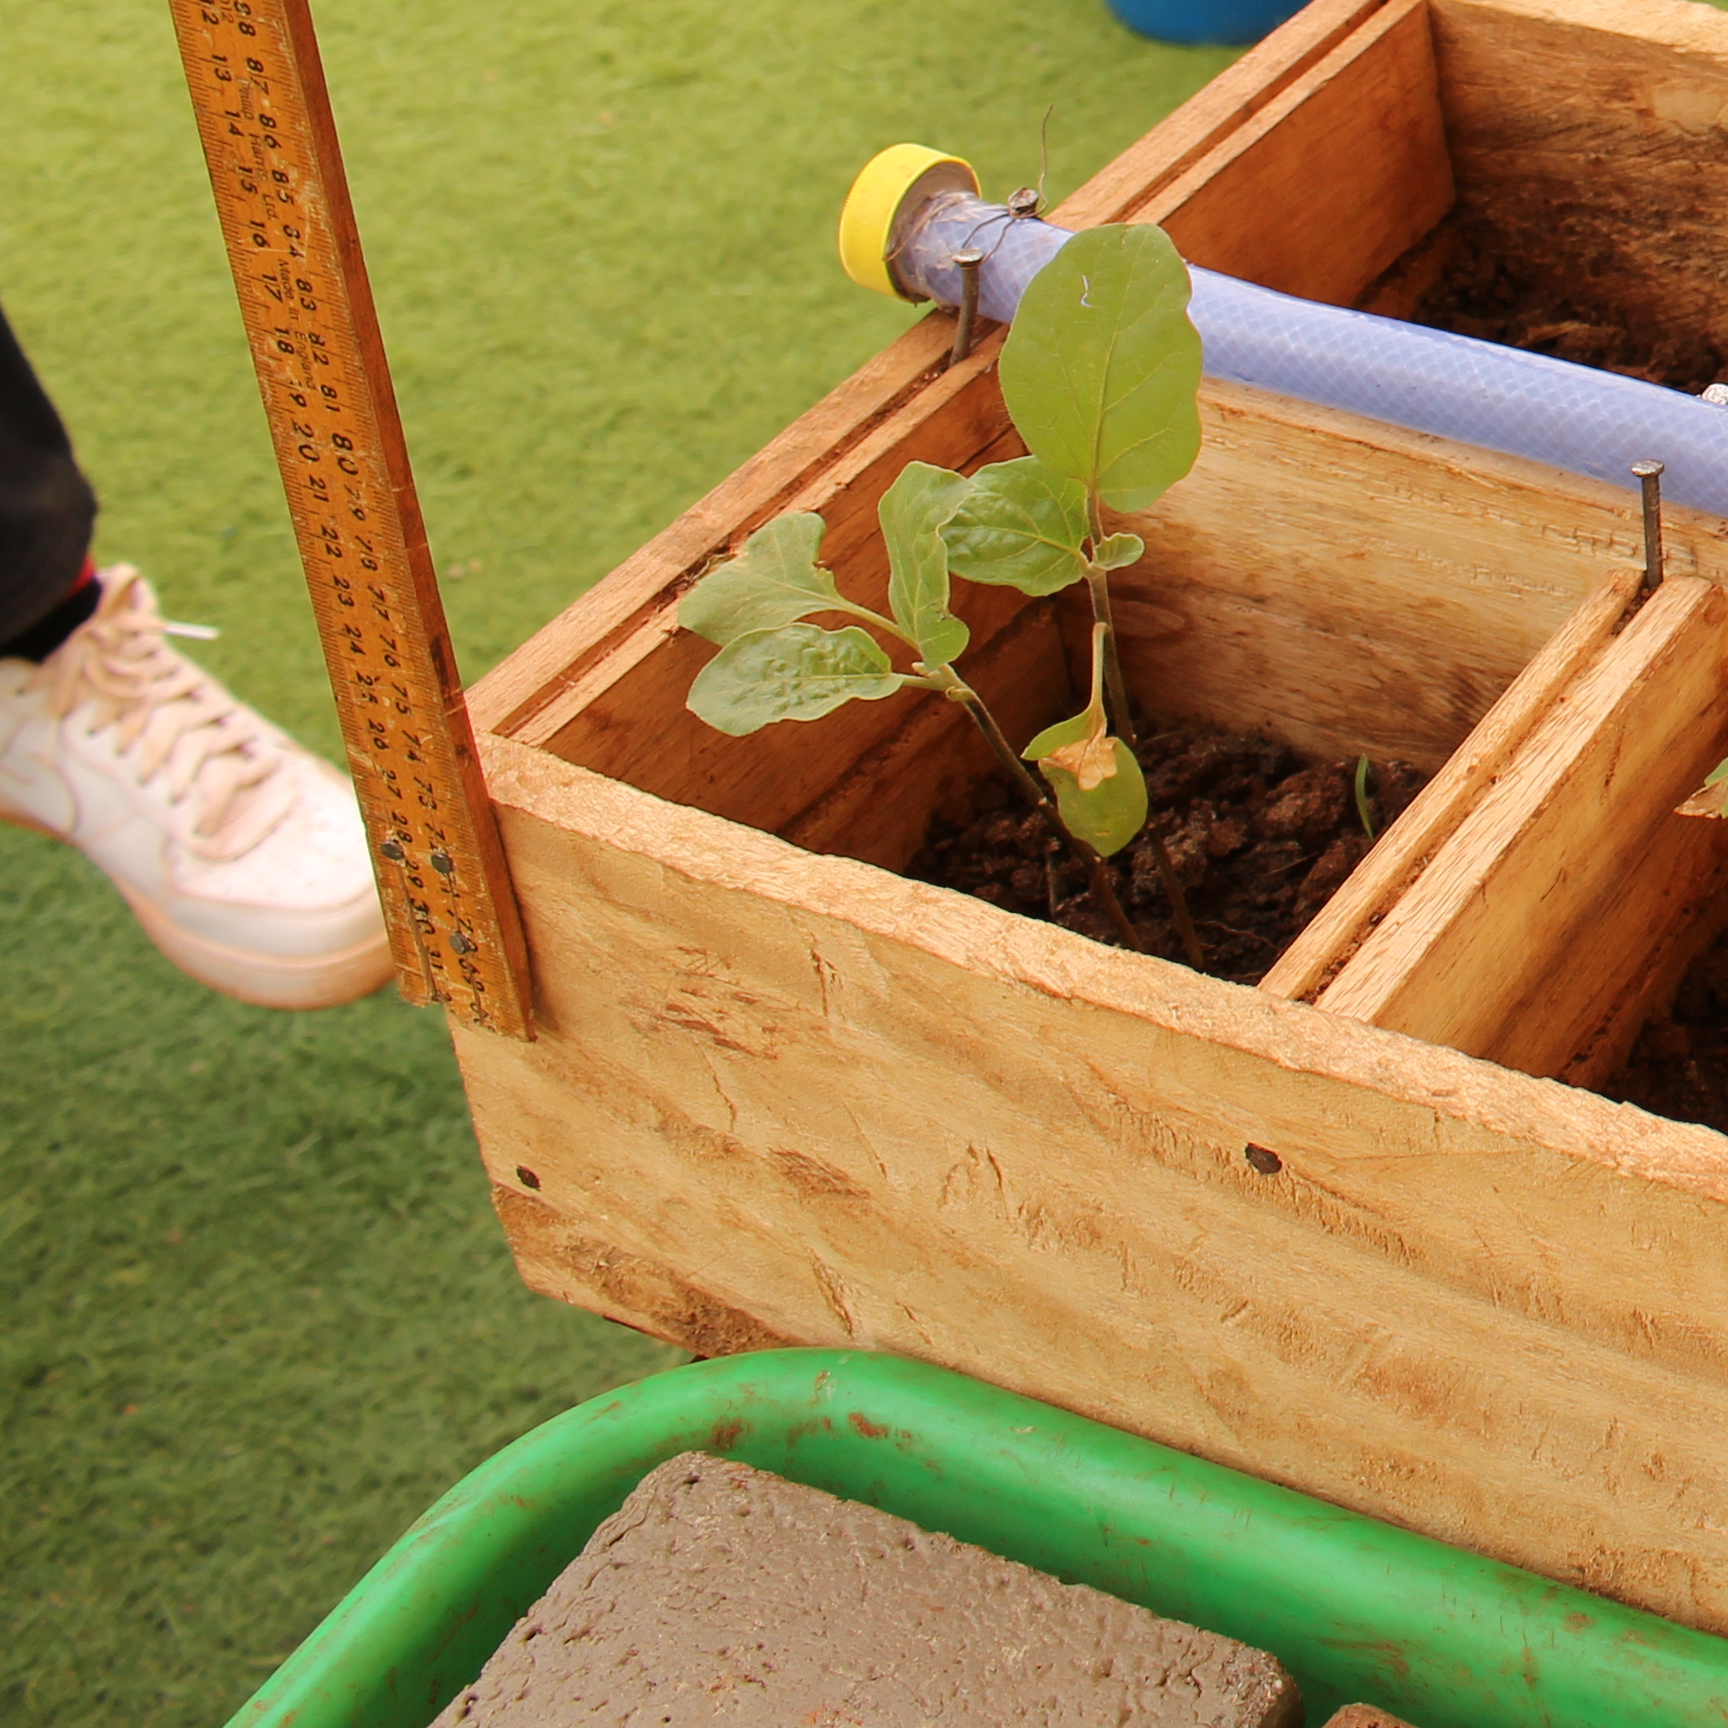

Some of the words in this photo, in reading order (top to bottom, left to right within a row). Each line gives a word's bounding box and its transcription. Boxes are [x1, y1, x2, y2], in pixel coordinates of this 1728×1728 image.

[233, 0, 256, 37] 88
[212, 54, 233, 83] 13
[246, 56, 270, 96] 87
[224, 110, 245, 137] 14
[259, 113, 282, 150] 86
[238, 164, 259, 195] 15
[271, 169, 294, 206] 85
[250, 220, 270, 249] 16
[282, 224, 306, 260] 84
[262, 273, 284, 304] 17
[296, 278, 317, 312] 83
[274, 326, 295, 356] 18
[277, 258, 294, 300] Made
[294, 330, 318, 391] England
[307, 331, 330, 366] 82
[320, 384, 341, 413] 81
[292, 419, 321, 463] 20
[331, 432, 359, 476] 80
[309, 474, 330, 504] 21
[343, 484, 367, 522] 79
[321, 525, 343, 559] 22
[333, 575, 355, 608] 23
[367, 584, 391, 622] 77
[344, 624, 367, 656] 24
[379, 634, 401, 668] 76
[391, 682, 412, 715] 75
[367, 719, 390, 751] 26
[402, 729, 425, 763] 74
[381, 769, 403, 800] 27
[413, 776, 437, 810] 73
[391, 811, 413, 844] 28
[404, 859, 424, 888] 29
